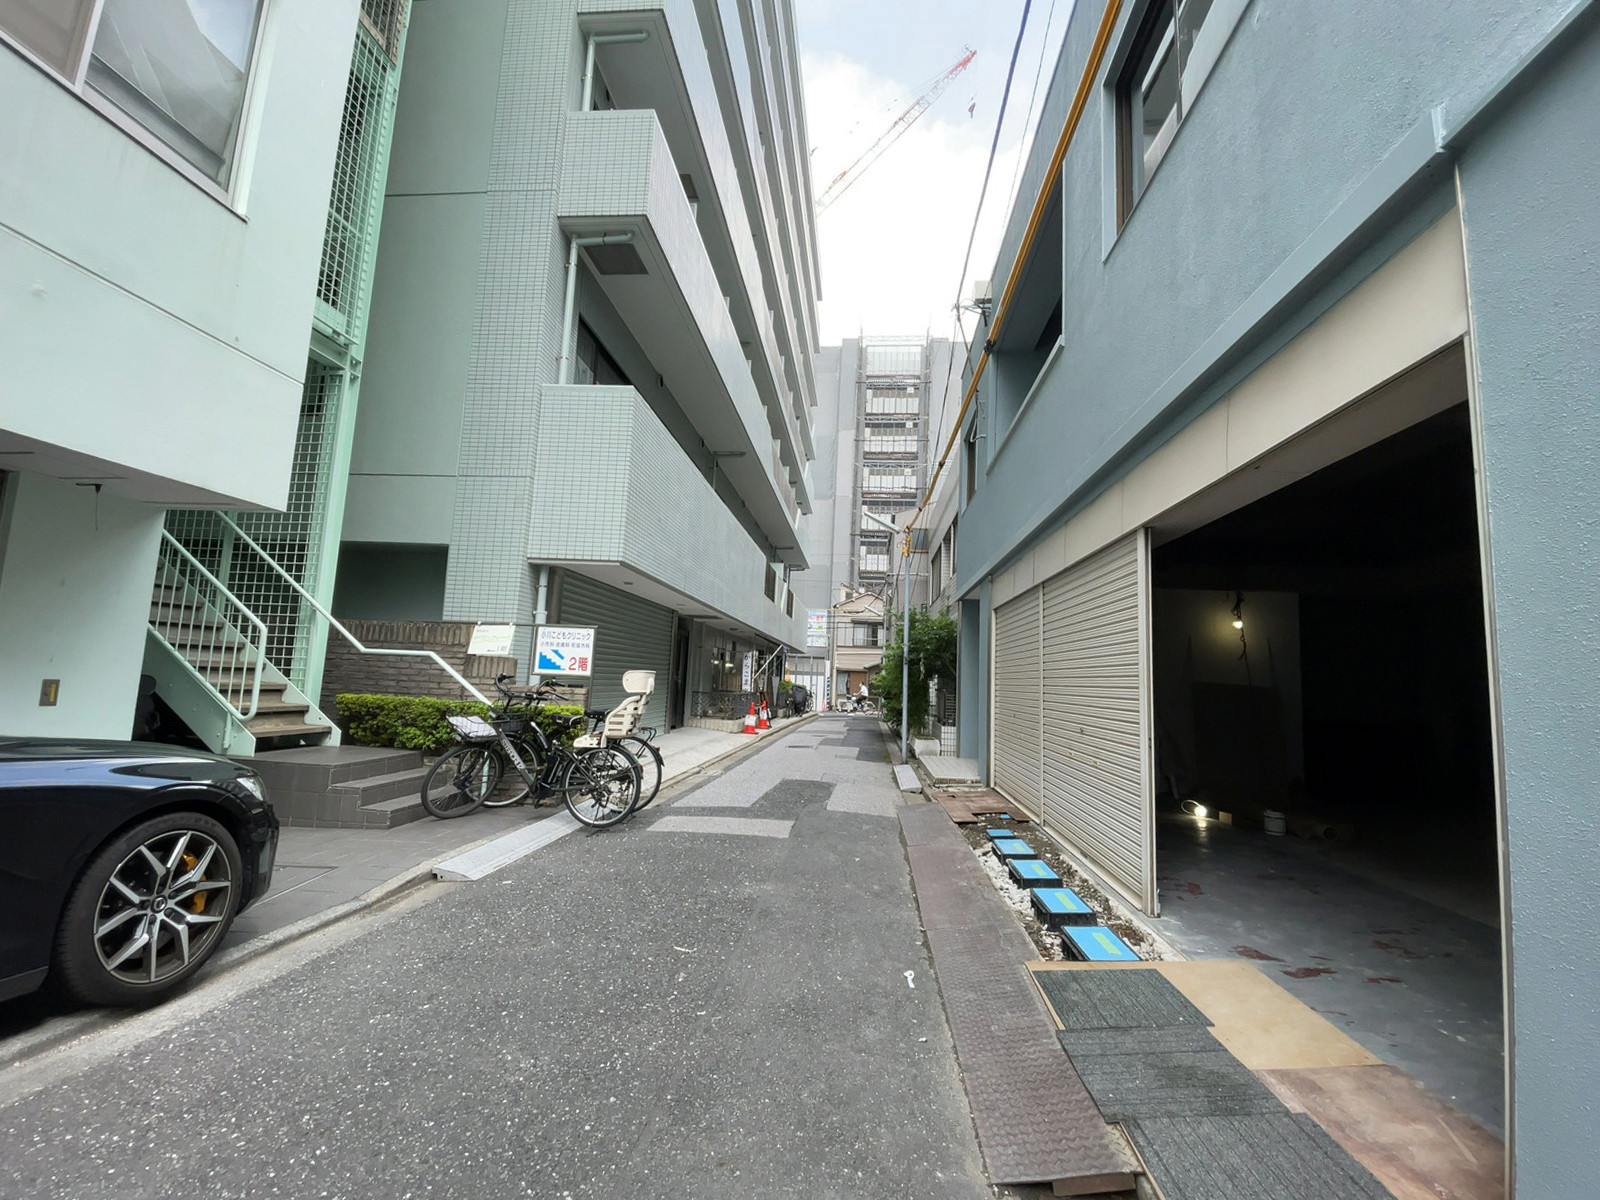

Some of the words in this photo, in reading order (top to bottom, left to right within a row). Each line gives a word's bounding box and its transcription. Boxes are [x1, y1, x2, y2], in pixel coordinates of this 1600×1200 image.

[541, 631, 591, 640] 小川こどもクリニック
[568, 656, 588, 671] 2階
